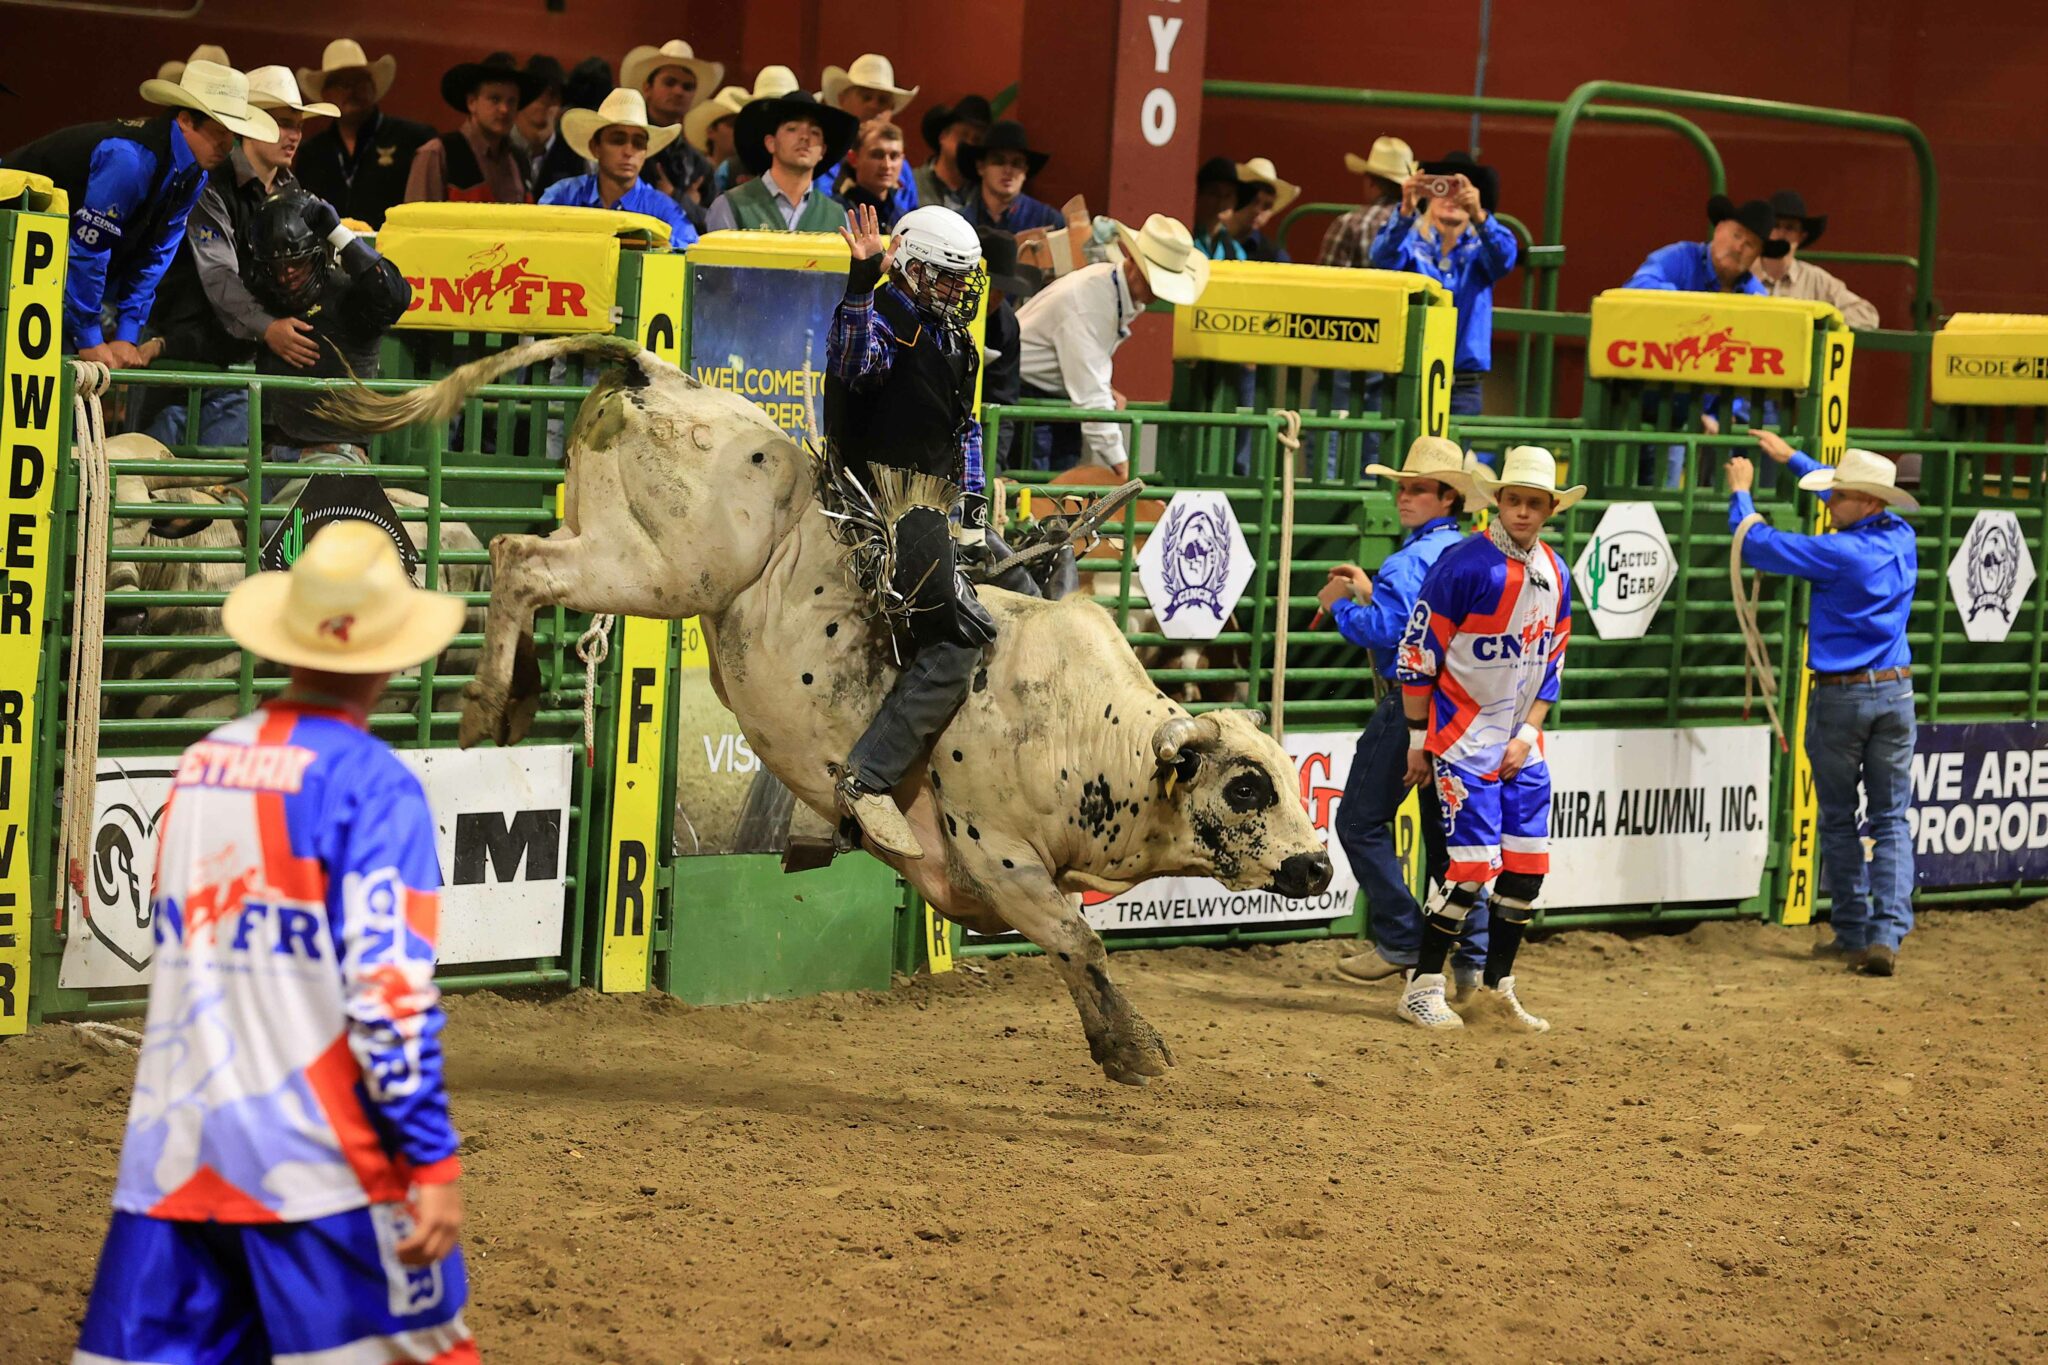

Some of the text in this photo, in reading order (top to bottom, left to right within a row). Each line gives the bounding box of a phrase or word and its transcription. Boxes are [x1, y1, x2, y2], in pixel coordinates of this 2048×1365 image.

[77, 225, 99, 244] 48
[1287, 313, 1379, 344] HOUSTON
[1606, 339, 1785, 376] CNFR
[697, 365, 804, 397] WELCOME
[1608, 544, 1658, 572] CACTUS
[1617, 572, 1656, 600] GEAR
[1909, 749, 2048, 801] WE ARE
[1551, 784, 1764, 841] NIRA ALUMNI, INC.
[1116, 890, 1348, 924] TRAVELWYOMING.COM
